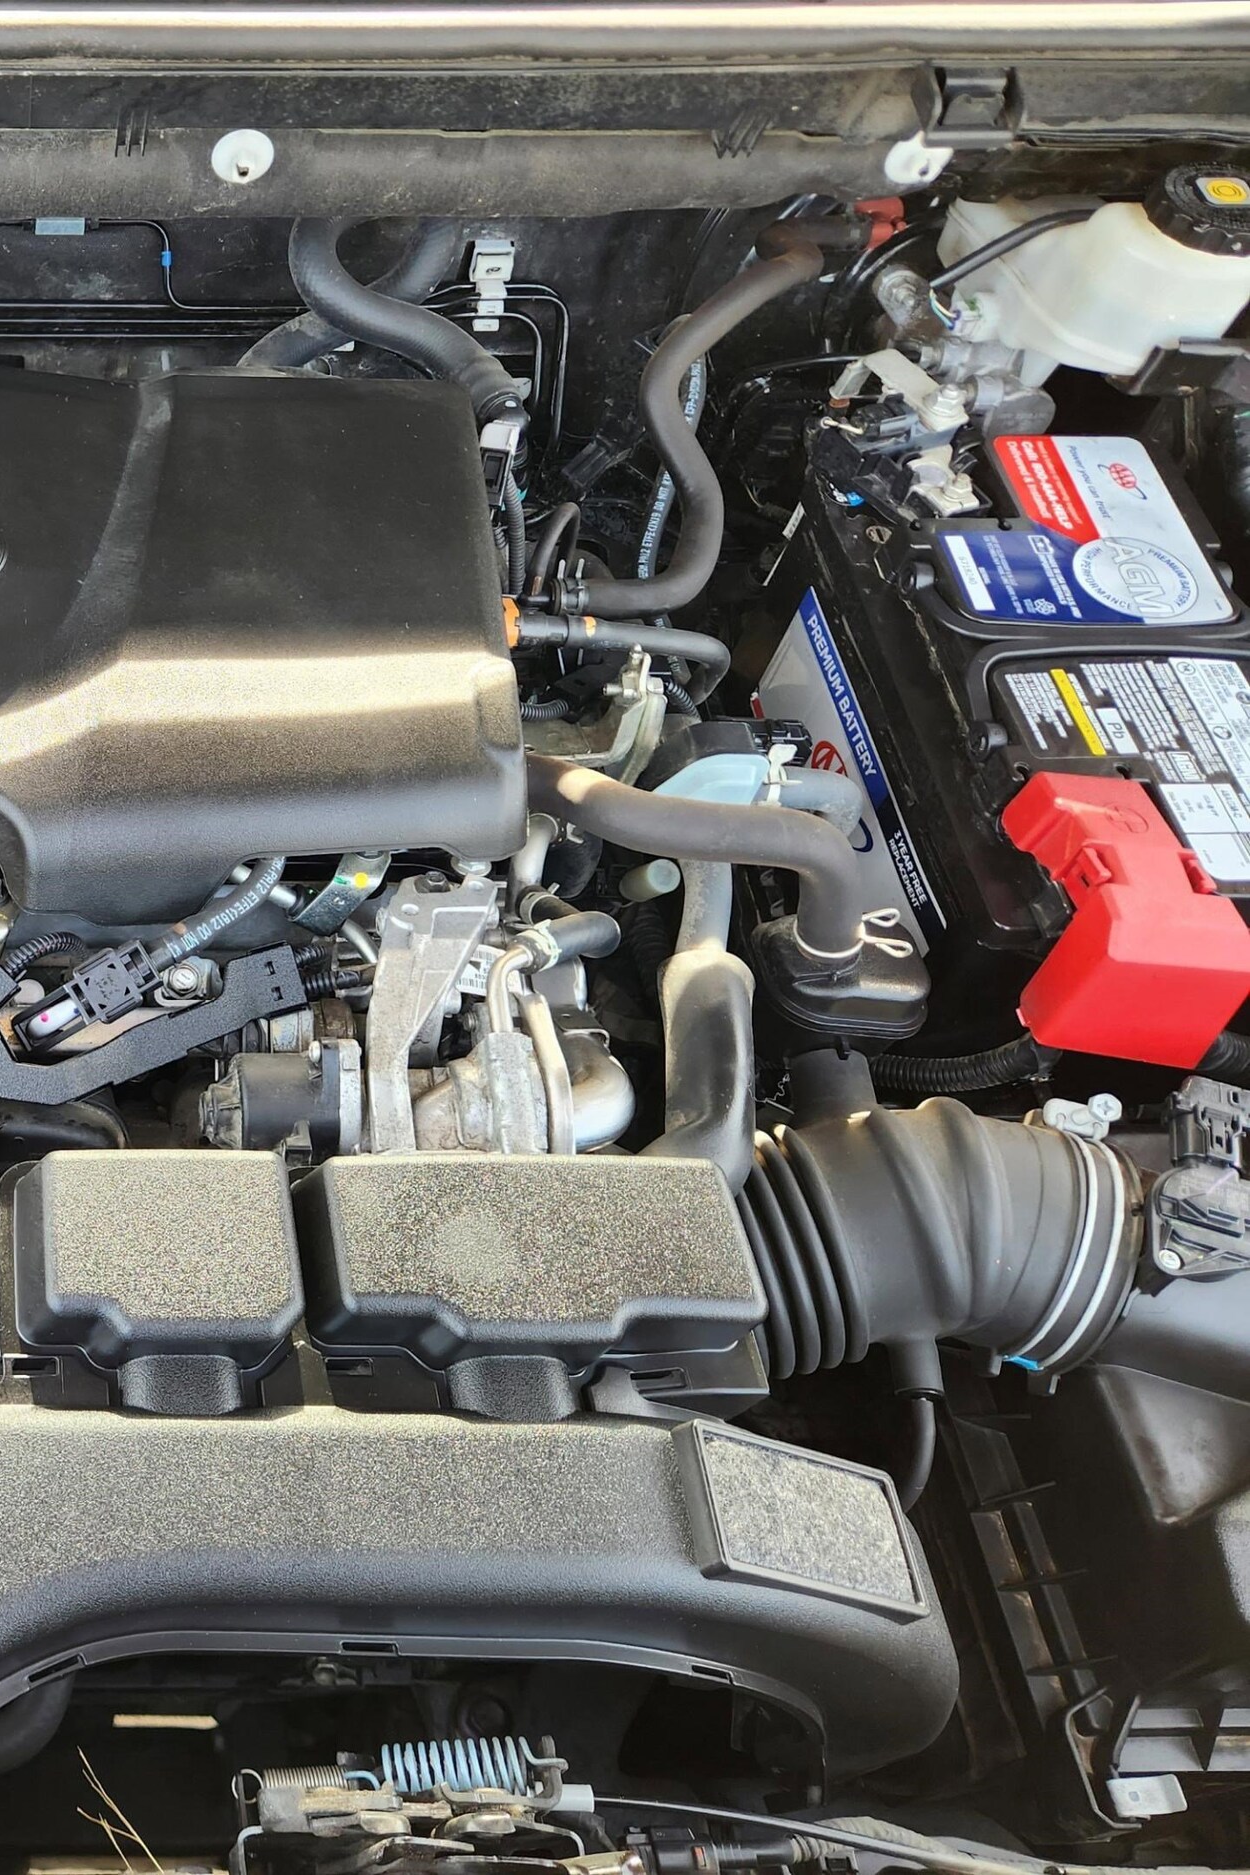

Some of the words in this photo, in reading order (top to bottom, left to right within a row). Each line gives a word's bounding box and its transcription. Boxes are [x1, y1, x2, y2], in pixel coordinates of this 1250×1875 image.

[1067, 445, 1084, 470] Power
[1076, 468, 1093, 486] you
[1088, 485, 1100, 500] can
[1095, 500, 1112, 519] trust
[1102, 540, 1175, 614] AGM
[1146, 548, 1187, 580] PREMIUM
[1174, 579, 1191, 608] BATTERY
[806, 613, 846, 698] PREMIUM
[838, 695, 878, 777] BATTERY
[1106, 722, 1126, 740] Pb
[893, 829, 902, 840] 3
[897, 838, 915, 873] YEAR
[909, 870, 928, 905] FREE
[180, 932, 200, 952] NOT
